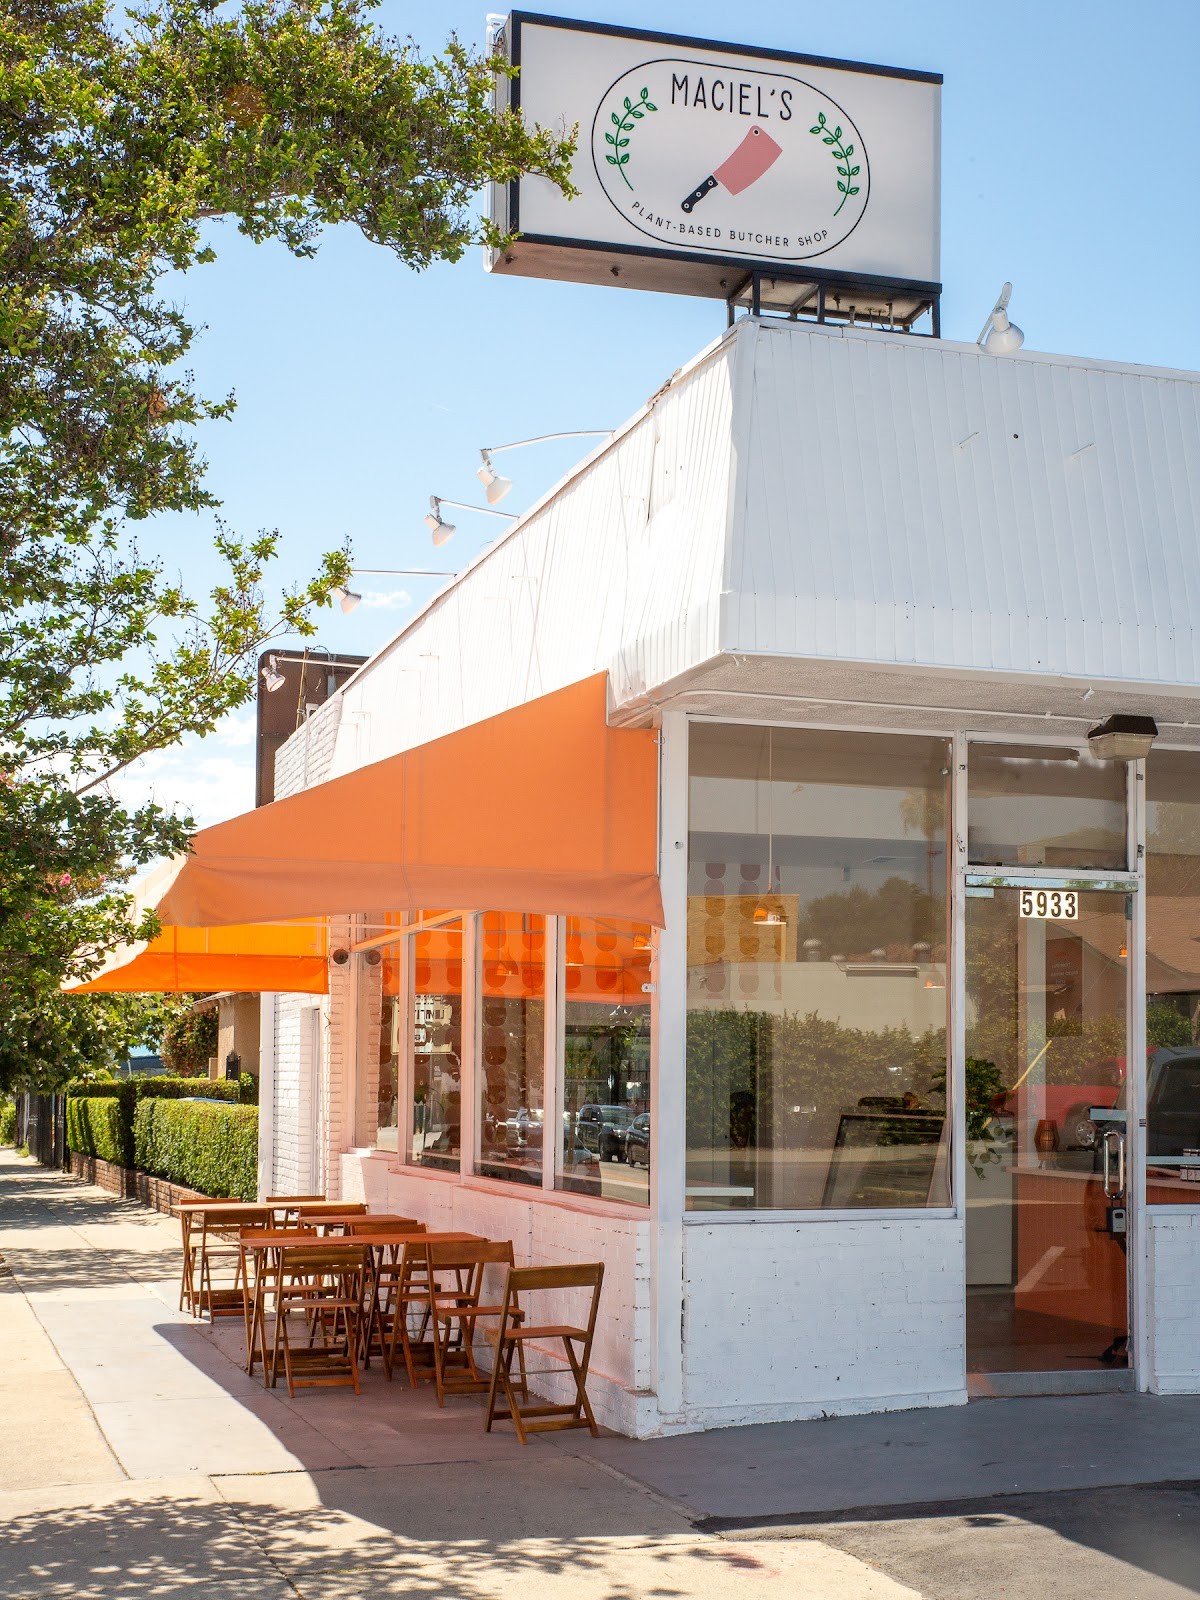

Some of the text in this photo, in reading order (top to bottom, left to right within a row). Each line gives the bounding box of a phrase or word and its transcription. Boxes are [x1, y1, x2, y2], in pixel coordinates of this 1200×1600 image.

[671, 73, 793, 121] MACIEL'S
[631, 201, 828, 247] PLANT-BASED BUTCHER SHOP
[1021, 891, 1076, 918] 5933
